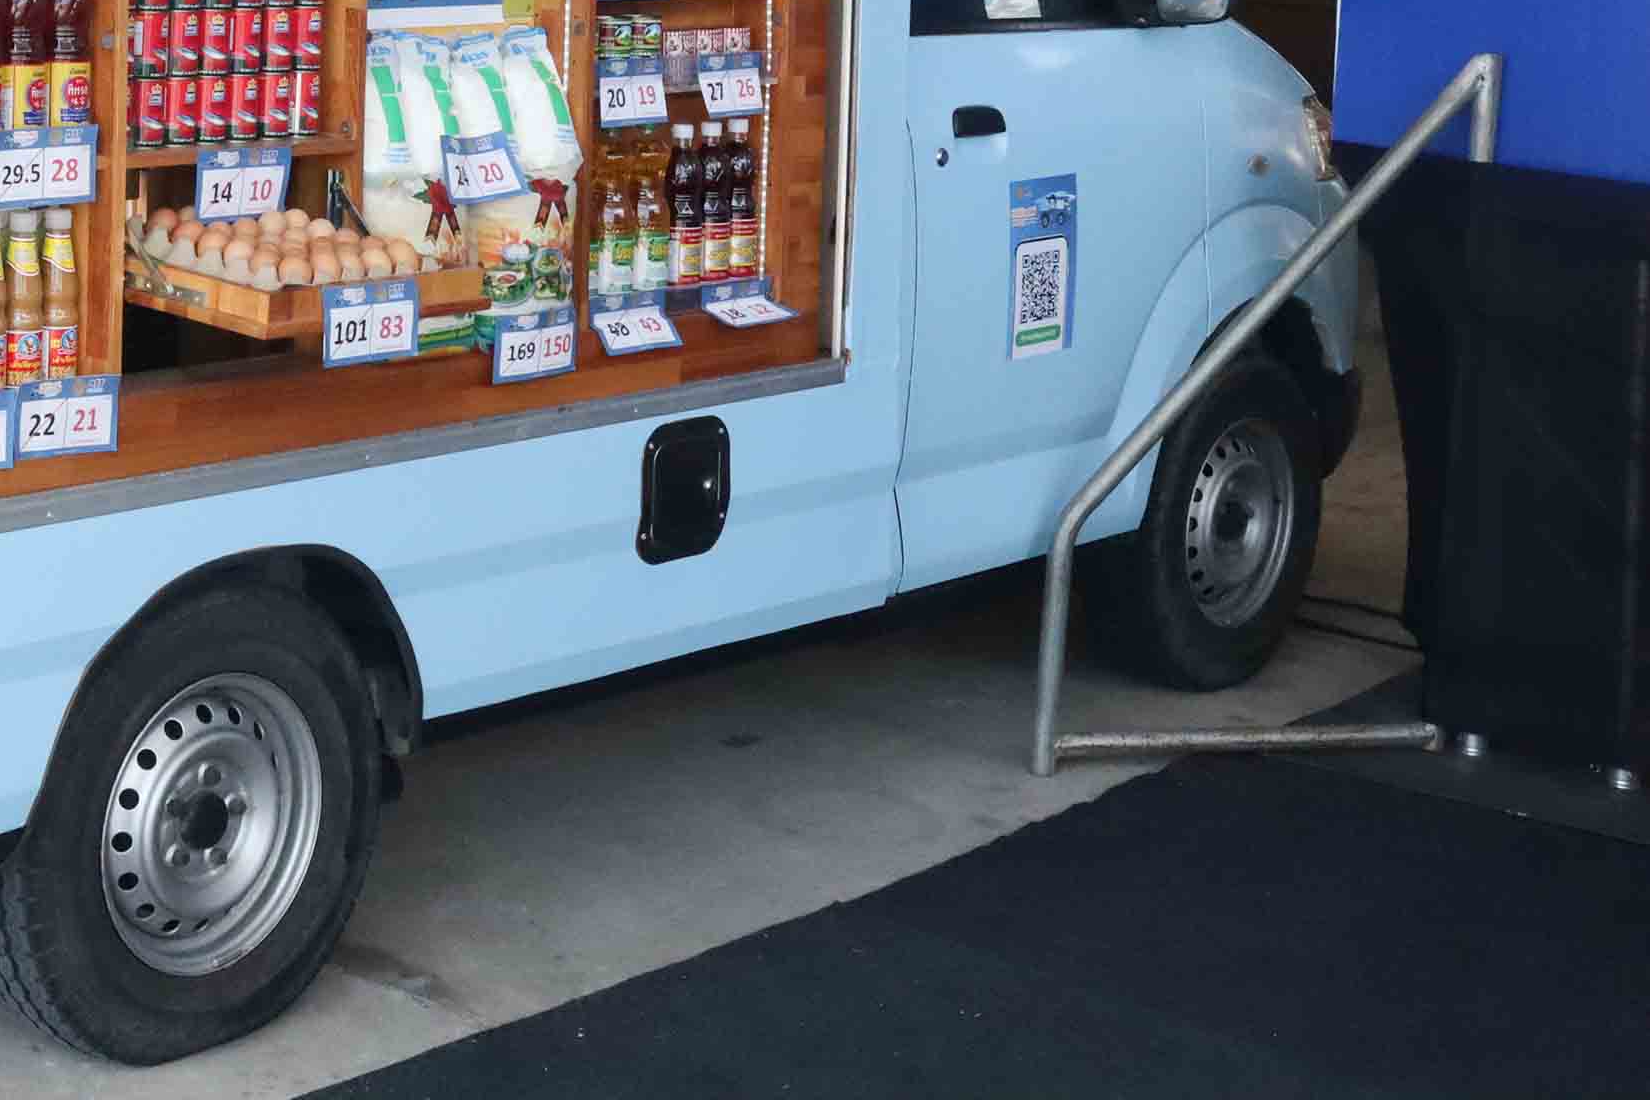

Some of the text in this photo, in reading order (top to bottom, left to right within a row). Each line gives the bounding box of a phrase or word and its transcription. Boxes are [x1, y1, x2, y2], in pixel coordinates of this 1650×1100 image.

[607, 85, 656, 108] 20 19
[707, 78, 755, 101] 27 26
[2, 158, 79, 186] 29.5 28
[478, 163, 504, 184] 20
[210, 179, 273, 205] 14 10
[334, 315, 404, 345] 101 83
[507, 334, 570, 362] 169 150
[29, 407, 98, 437] 22 21
